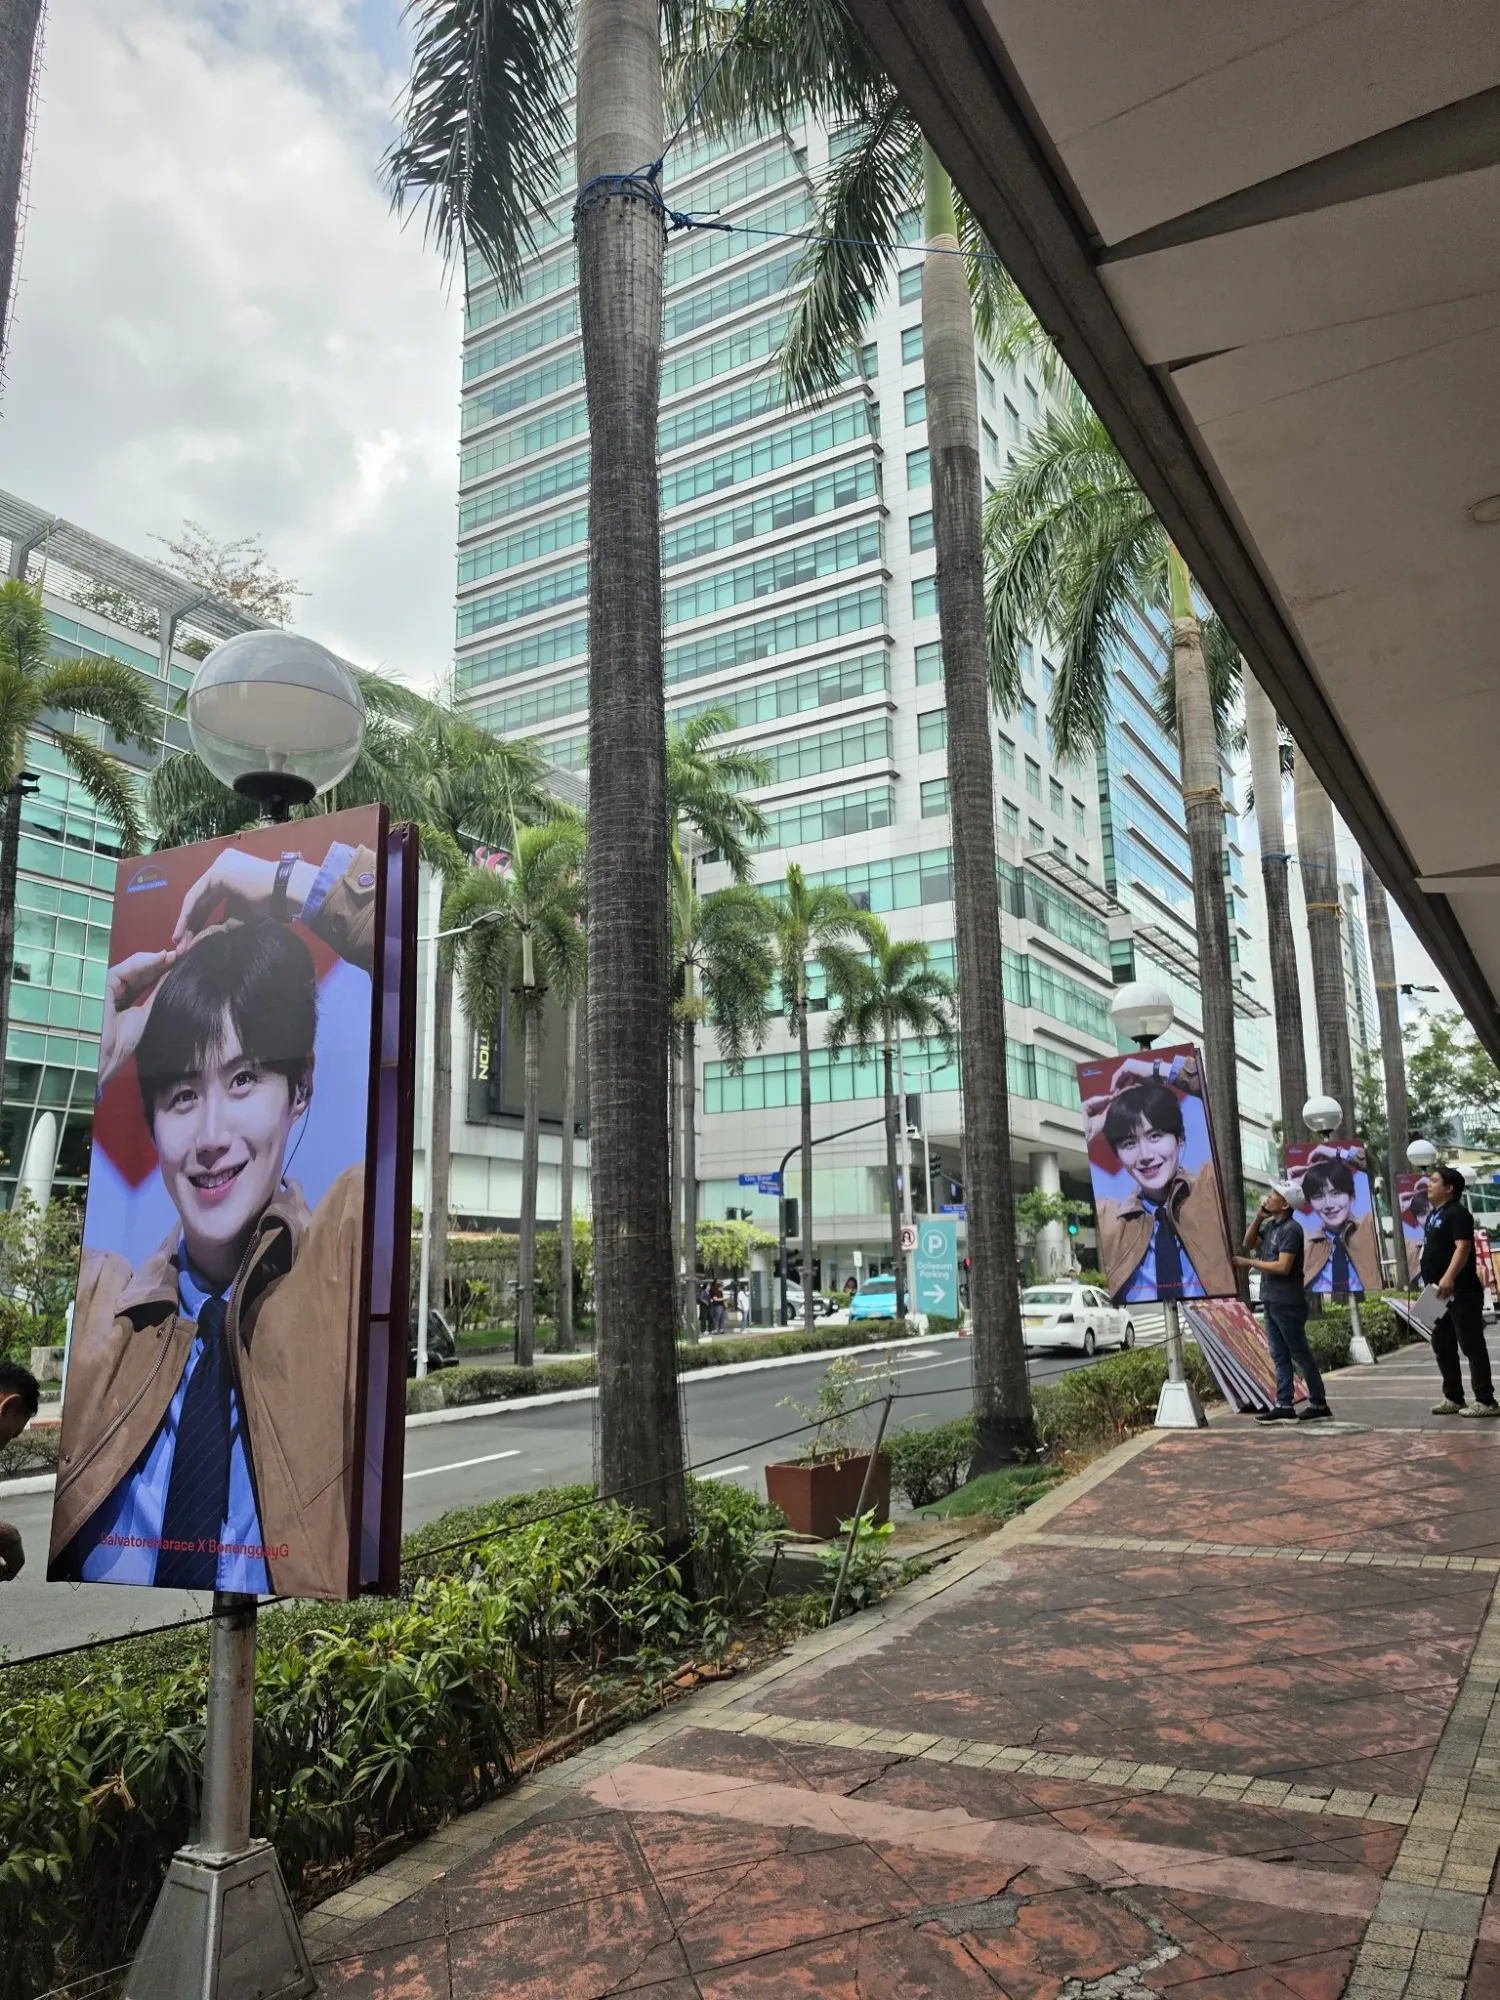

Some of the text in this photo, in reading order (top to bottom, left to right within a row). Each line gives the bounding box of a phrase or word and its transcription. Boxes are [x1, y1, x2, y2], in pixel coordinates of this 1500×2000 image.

[928, 1235, 942, 1253] P
[917, 1261, 952, 1270] Coliseum
[920, 1270, 949, 1280] Parking
[197, 1539, 206, 1552] X
